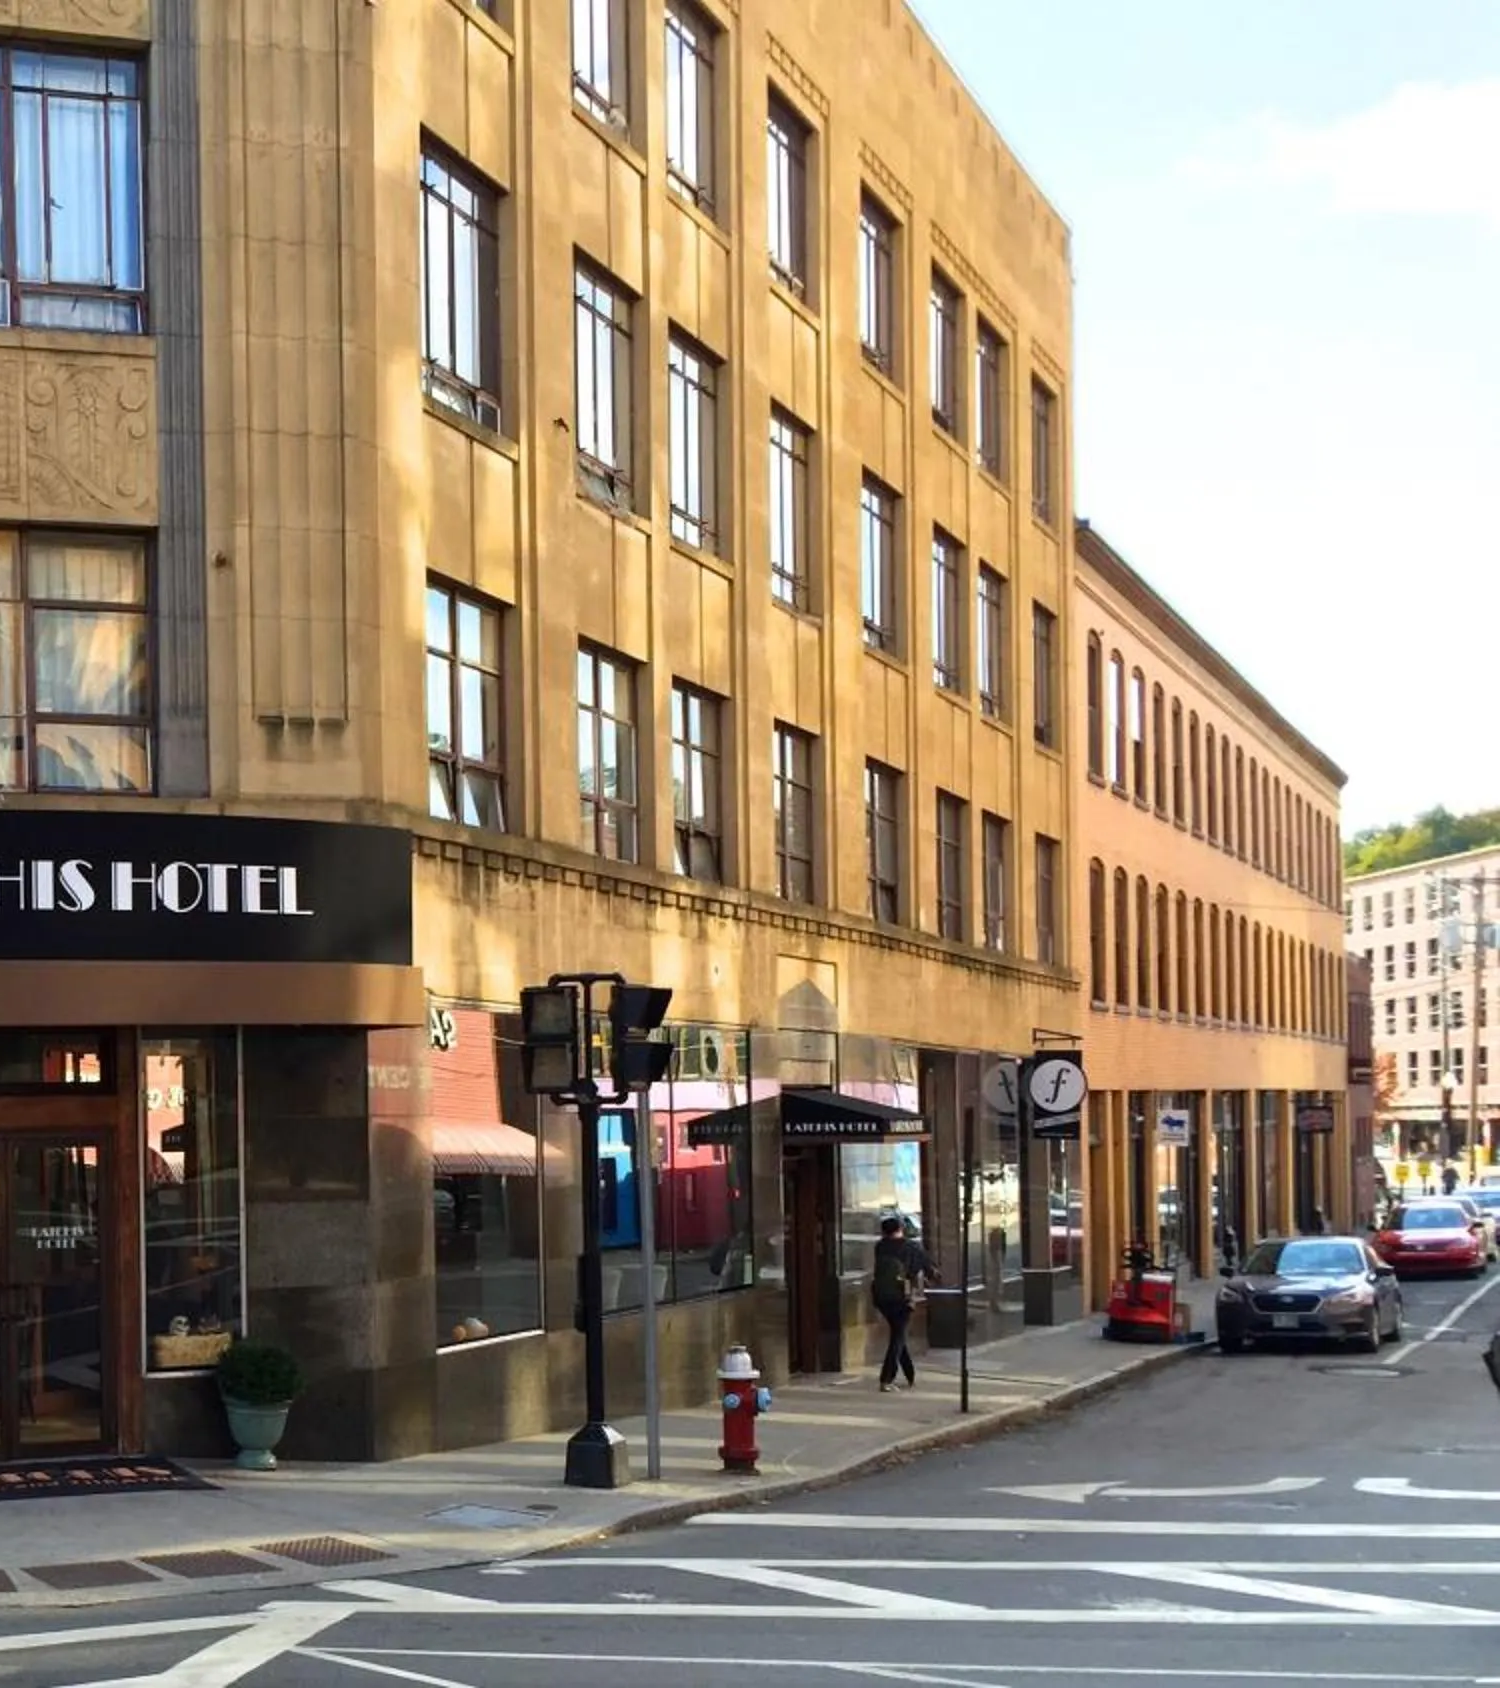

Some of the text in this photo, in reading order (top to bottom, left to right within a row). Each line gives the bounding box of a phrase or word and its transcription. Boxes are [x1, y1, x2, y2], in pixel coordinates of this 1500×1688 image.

[111, 860, 314, 916] HOTEL
[785, 1120, 837, 1133] LATCHIS
[838, 1121, 880, 1133] HOTEL
